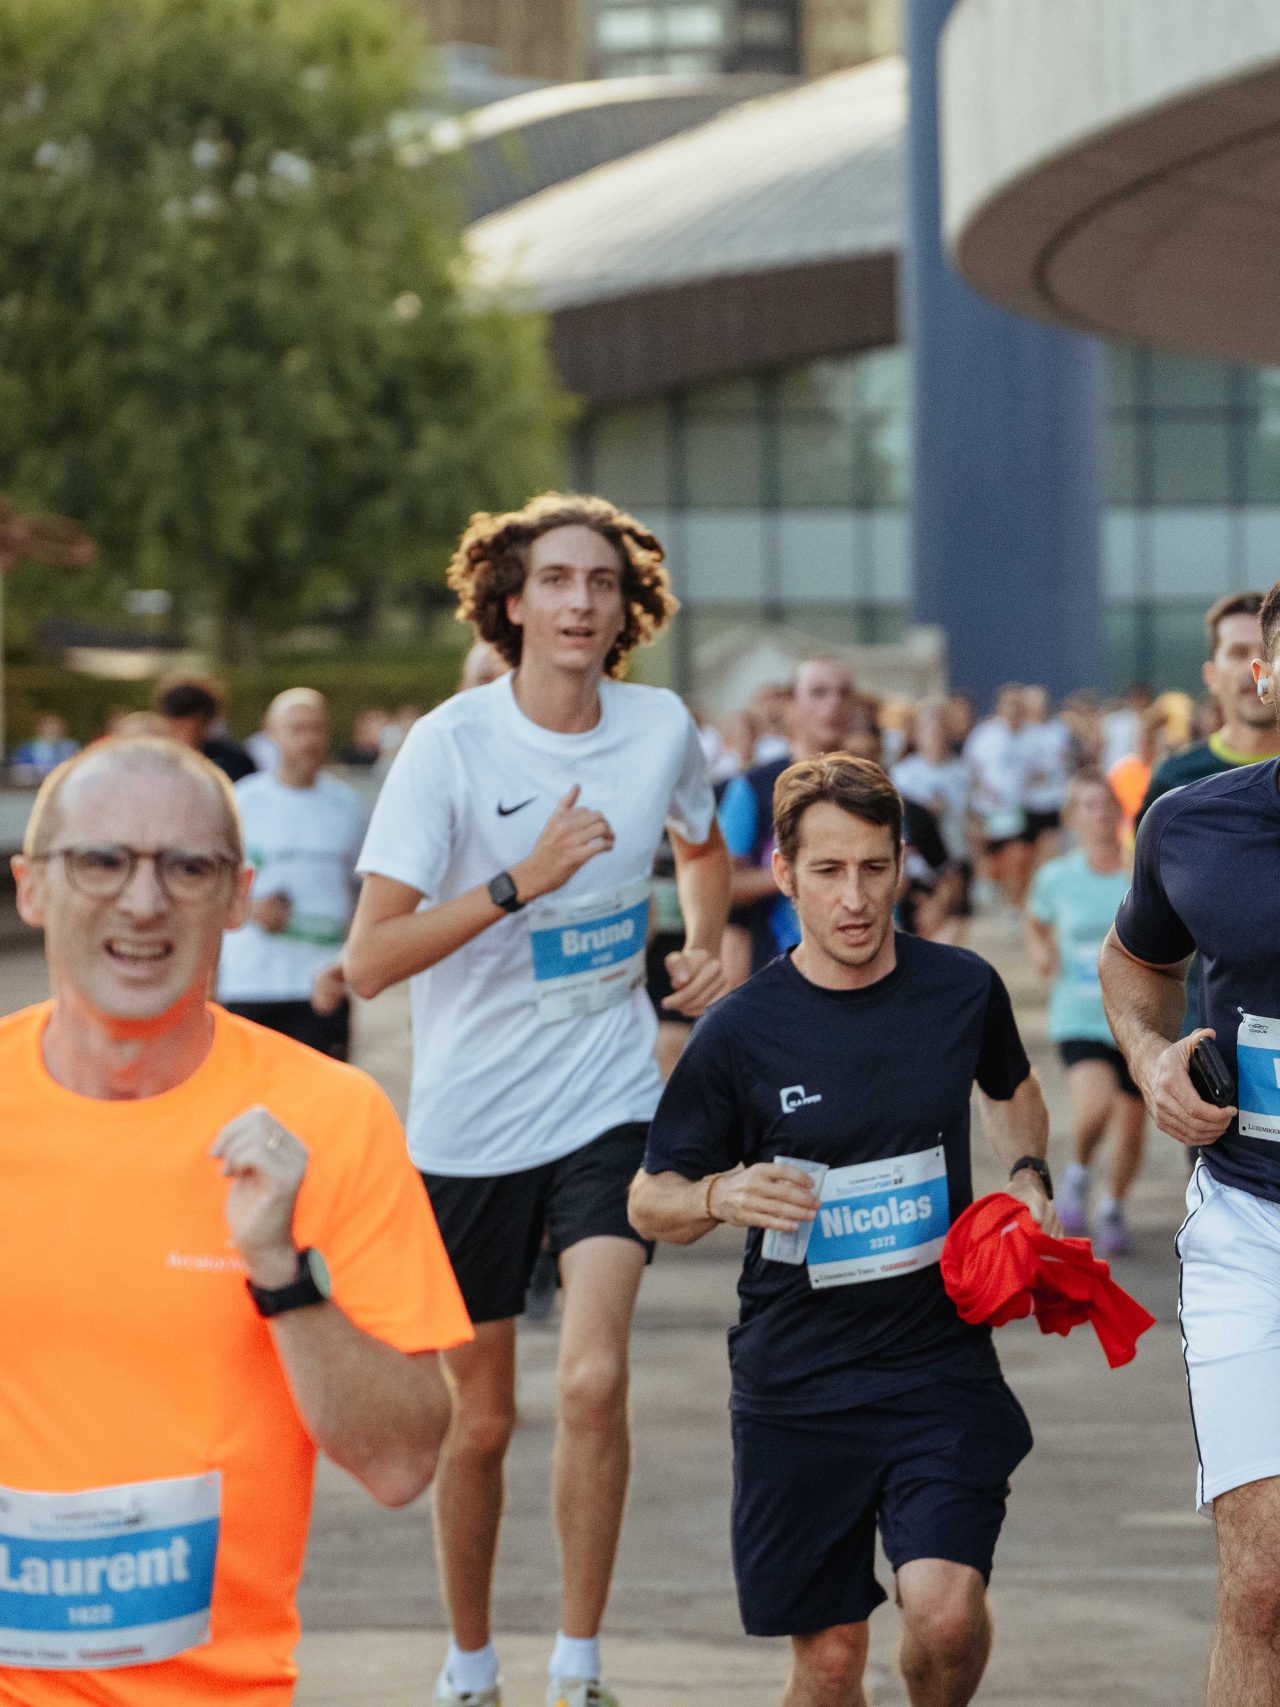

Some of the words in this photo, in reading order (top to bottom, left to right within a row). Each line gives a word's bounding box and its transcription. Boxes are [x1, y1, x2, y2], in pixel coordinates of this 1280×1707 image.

[561, 918, 635, 957] Bruno
[820, 1195, 933, 1239] Nicolas
[0, 1535, 191, 1596] Laurent
